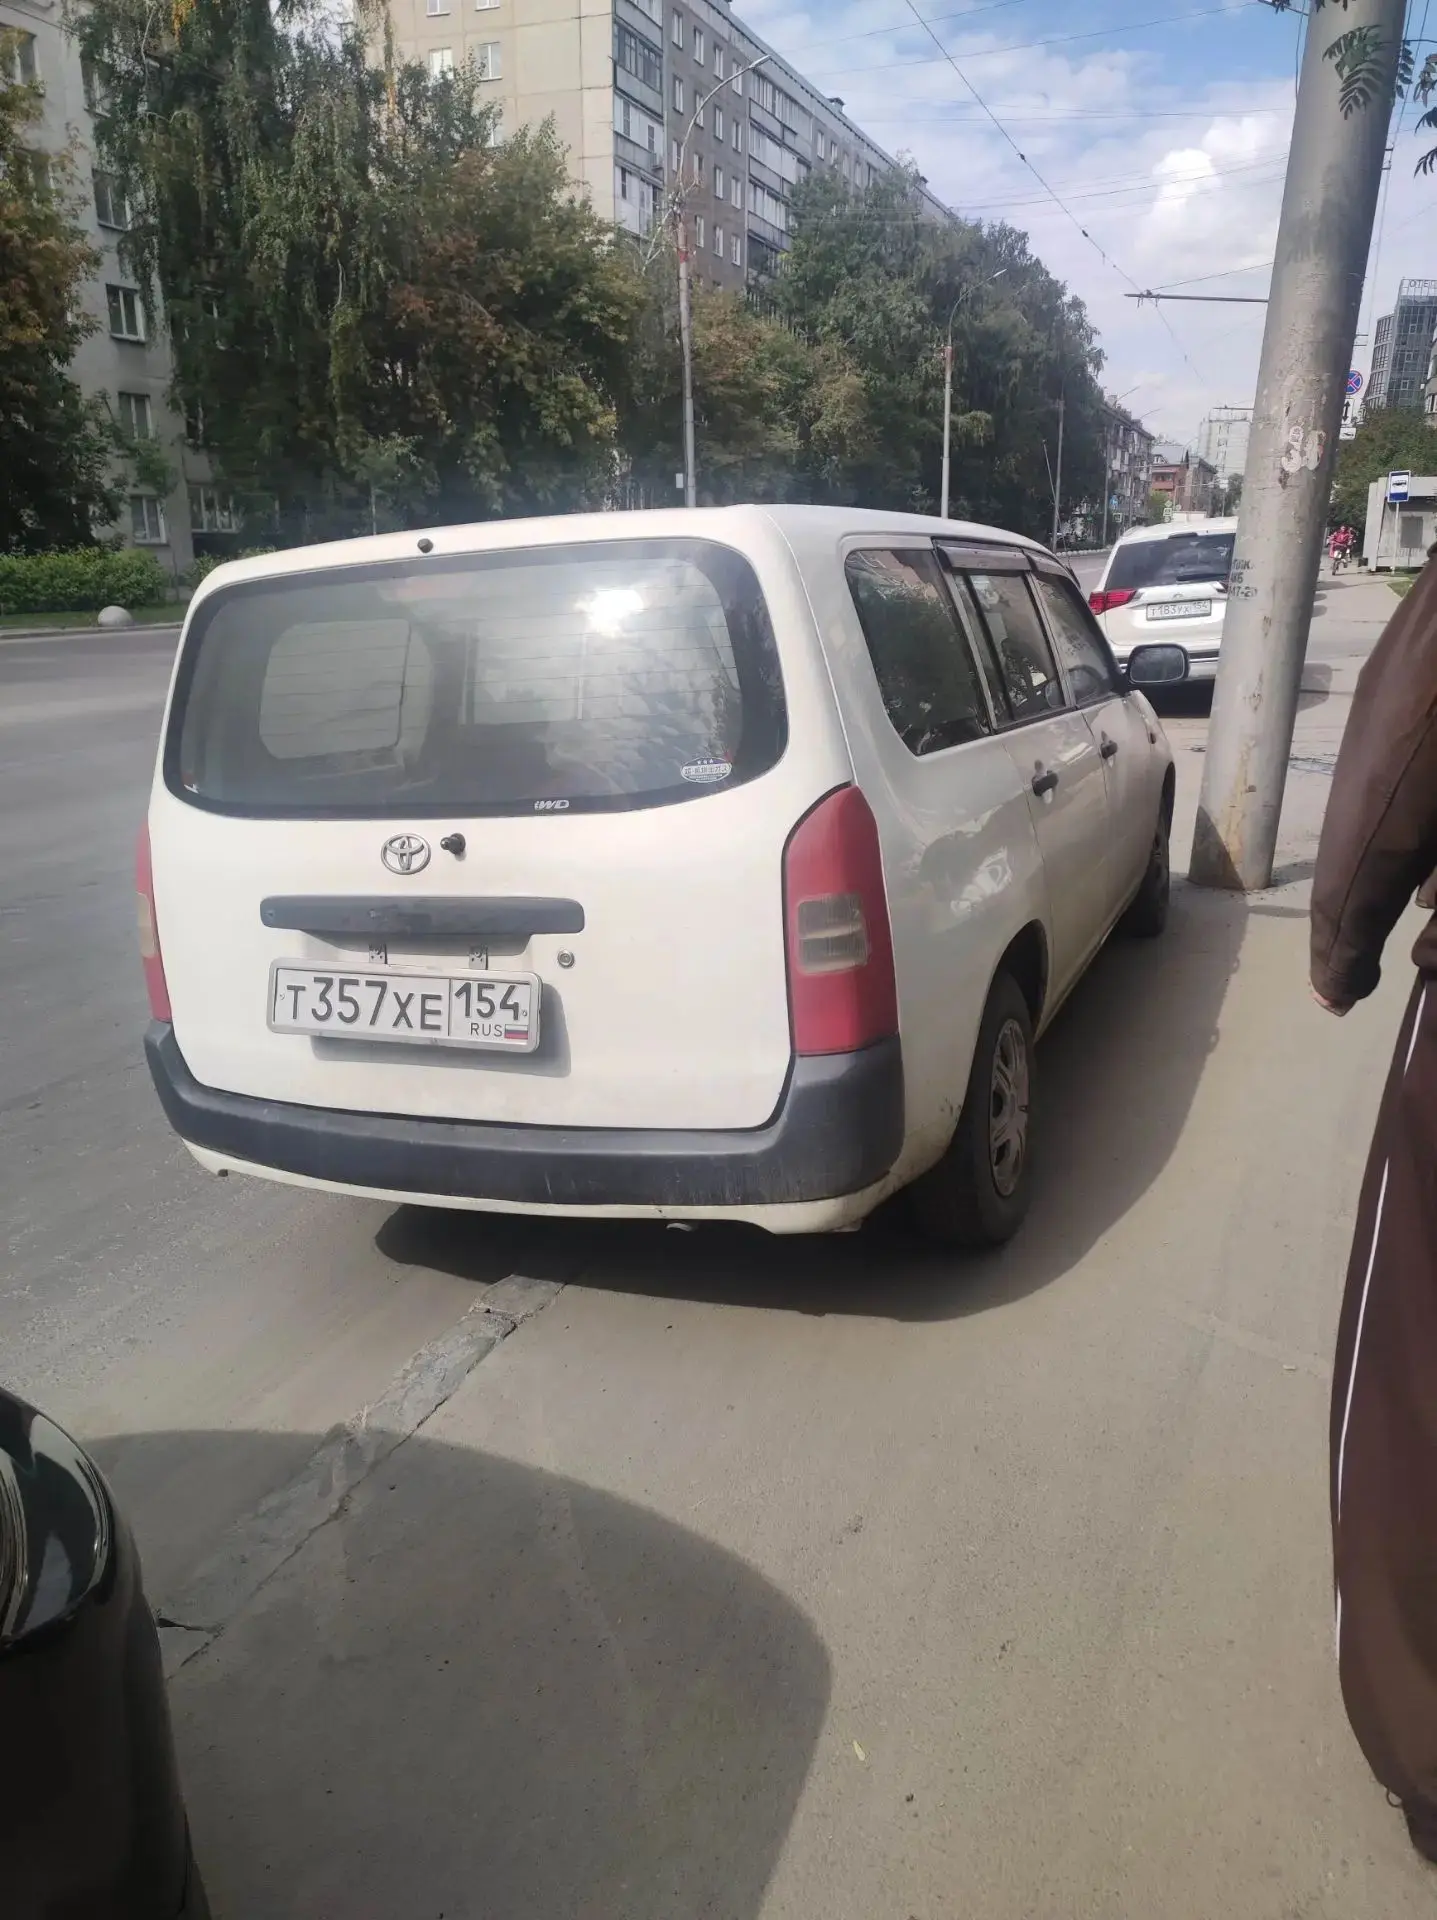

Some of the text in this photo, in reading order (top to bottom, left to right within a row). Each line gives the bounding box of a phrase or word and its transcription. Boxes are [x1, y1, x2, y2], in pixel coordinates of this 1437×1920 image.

[286, 976, 520, 1031] Т357ХЕ 154
[470, 1022, 503, 1038] RUS
